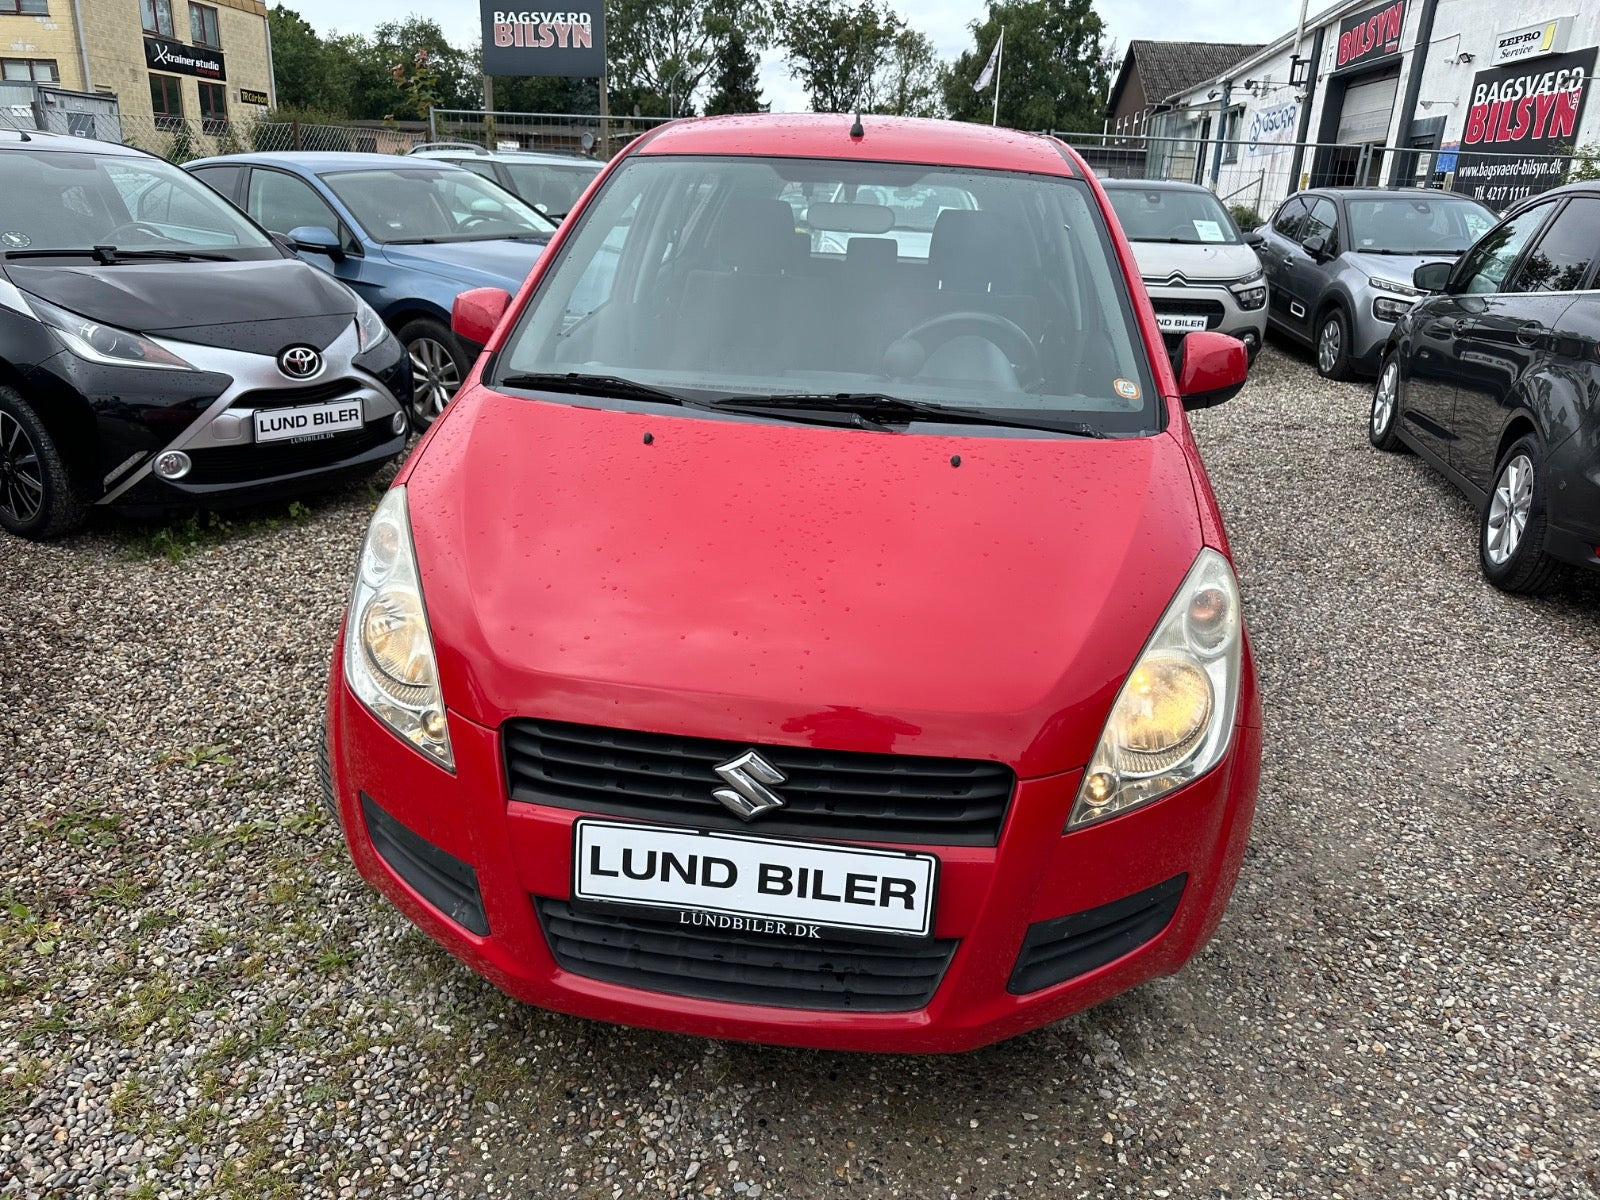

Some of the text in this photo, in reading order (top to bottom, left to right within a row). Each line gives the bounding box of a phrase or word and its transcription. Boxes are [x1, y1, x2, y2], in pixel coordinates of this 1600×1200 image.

[494, 11, 591, 25] BAGSVÆRD
[494, 22, 592, 48] BILSYN
[1338, 1, 1403, 65] BILSYN
[1498, 31, 1541, 48] ZEPRO
[154, 43, 220, 71] X-trainer studio
[1500, 45, 1534, 59] Service
[1474, 67, 1585, 106] BAGSVÆRD
[1263, 106, 1296, 132] OSCAR
[1465, 86, 1582, 144] BILSYN
[1459, 159, 1563, 180] www.bagsvaerd-bilsyn.dk
[1486, 186, 1507, 200] 4217
[1508, 186, 1531, 200] 1111
[1175, 319, 1205, 327] BILER
[260, 408, 359, 433] LUND BILER
[590, 845, 917, 910] LUND BILER
[680, 911, 821, 939] LUNDBILER.DK
